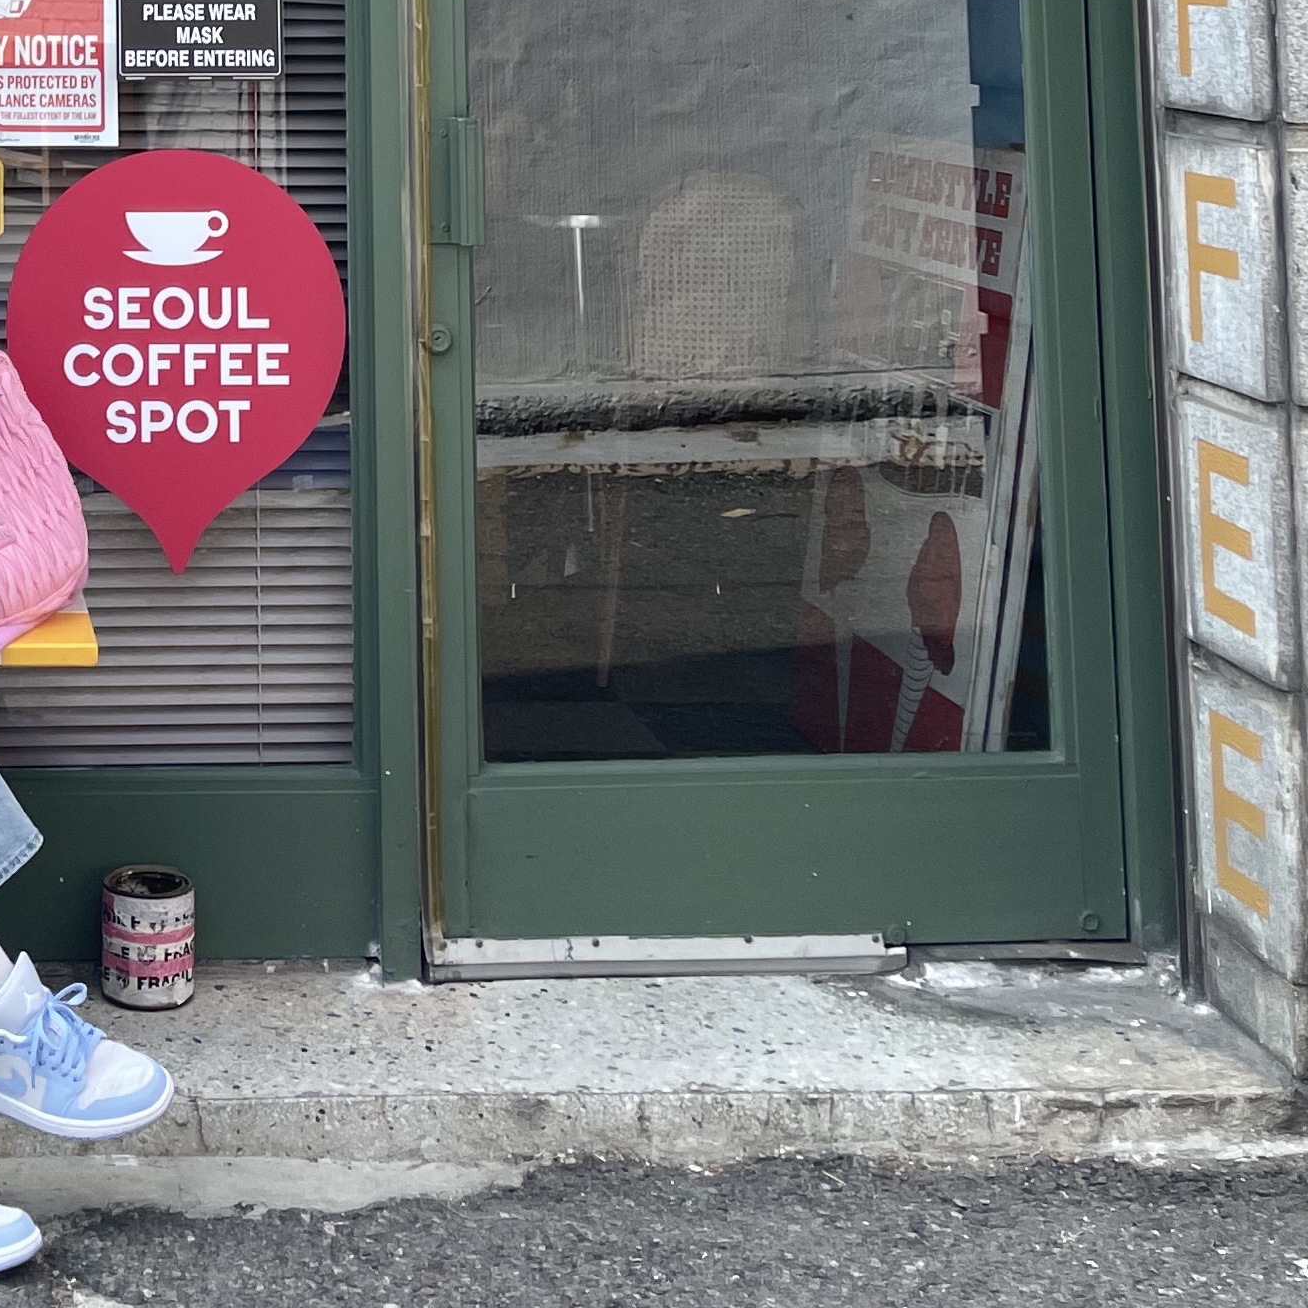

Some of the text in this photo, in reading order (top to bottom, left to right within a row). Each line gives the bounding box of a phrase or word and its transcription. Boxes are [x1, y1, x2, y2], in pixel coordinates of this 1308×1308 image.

[142, 3, 256, 21] PLEASE WEAR
[176, 26, 224, 44] MASK
[14, 34, 99, 66] NOTICE
[125, 49, 275, 67] BEFORE ENTERING
[7, 75, 77, 89] PROTECTED
[81, 75, 97, 89] BY
[39, 94, 96, 108] CAMERAS
[83, 286, 270, 330] SEOUL
[63, 343, 290, 387] COFFEE
[105, 399, 251, 444] SPOT
